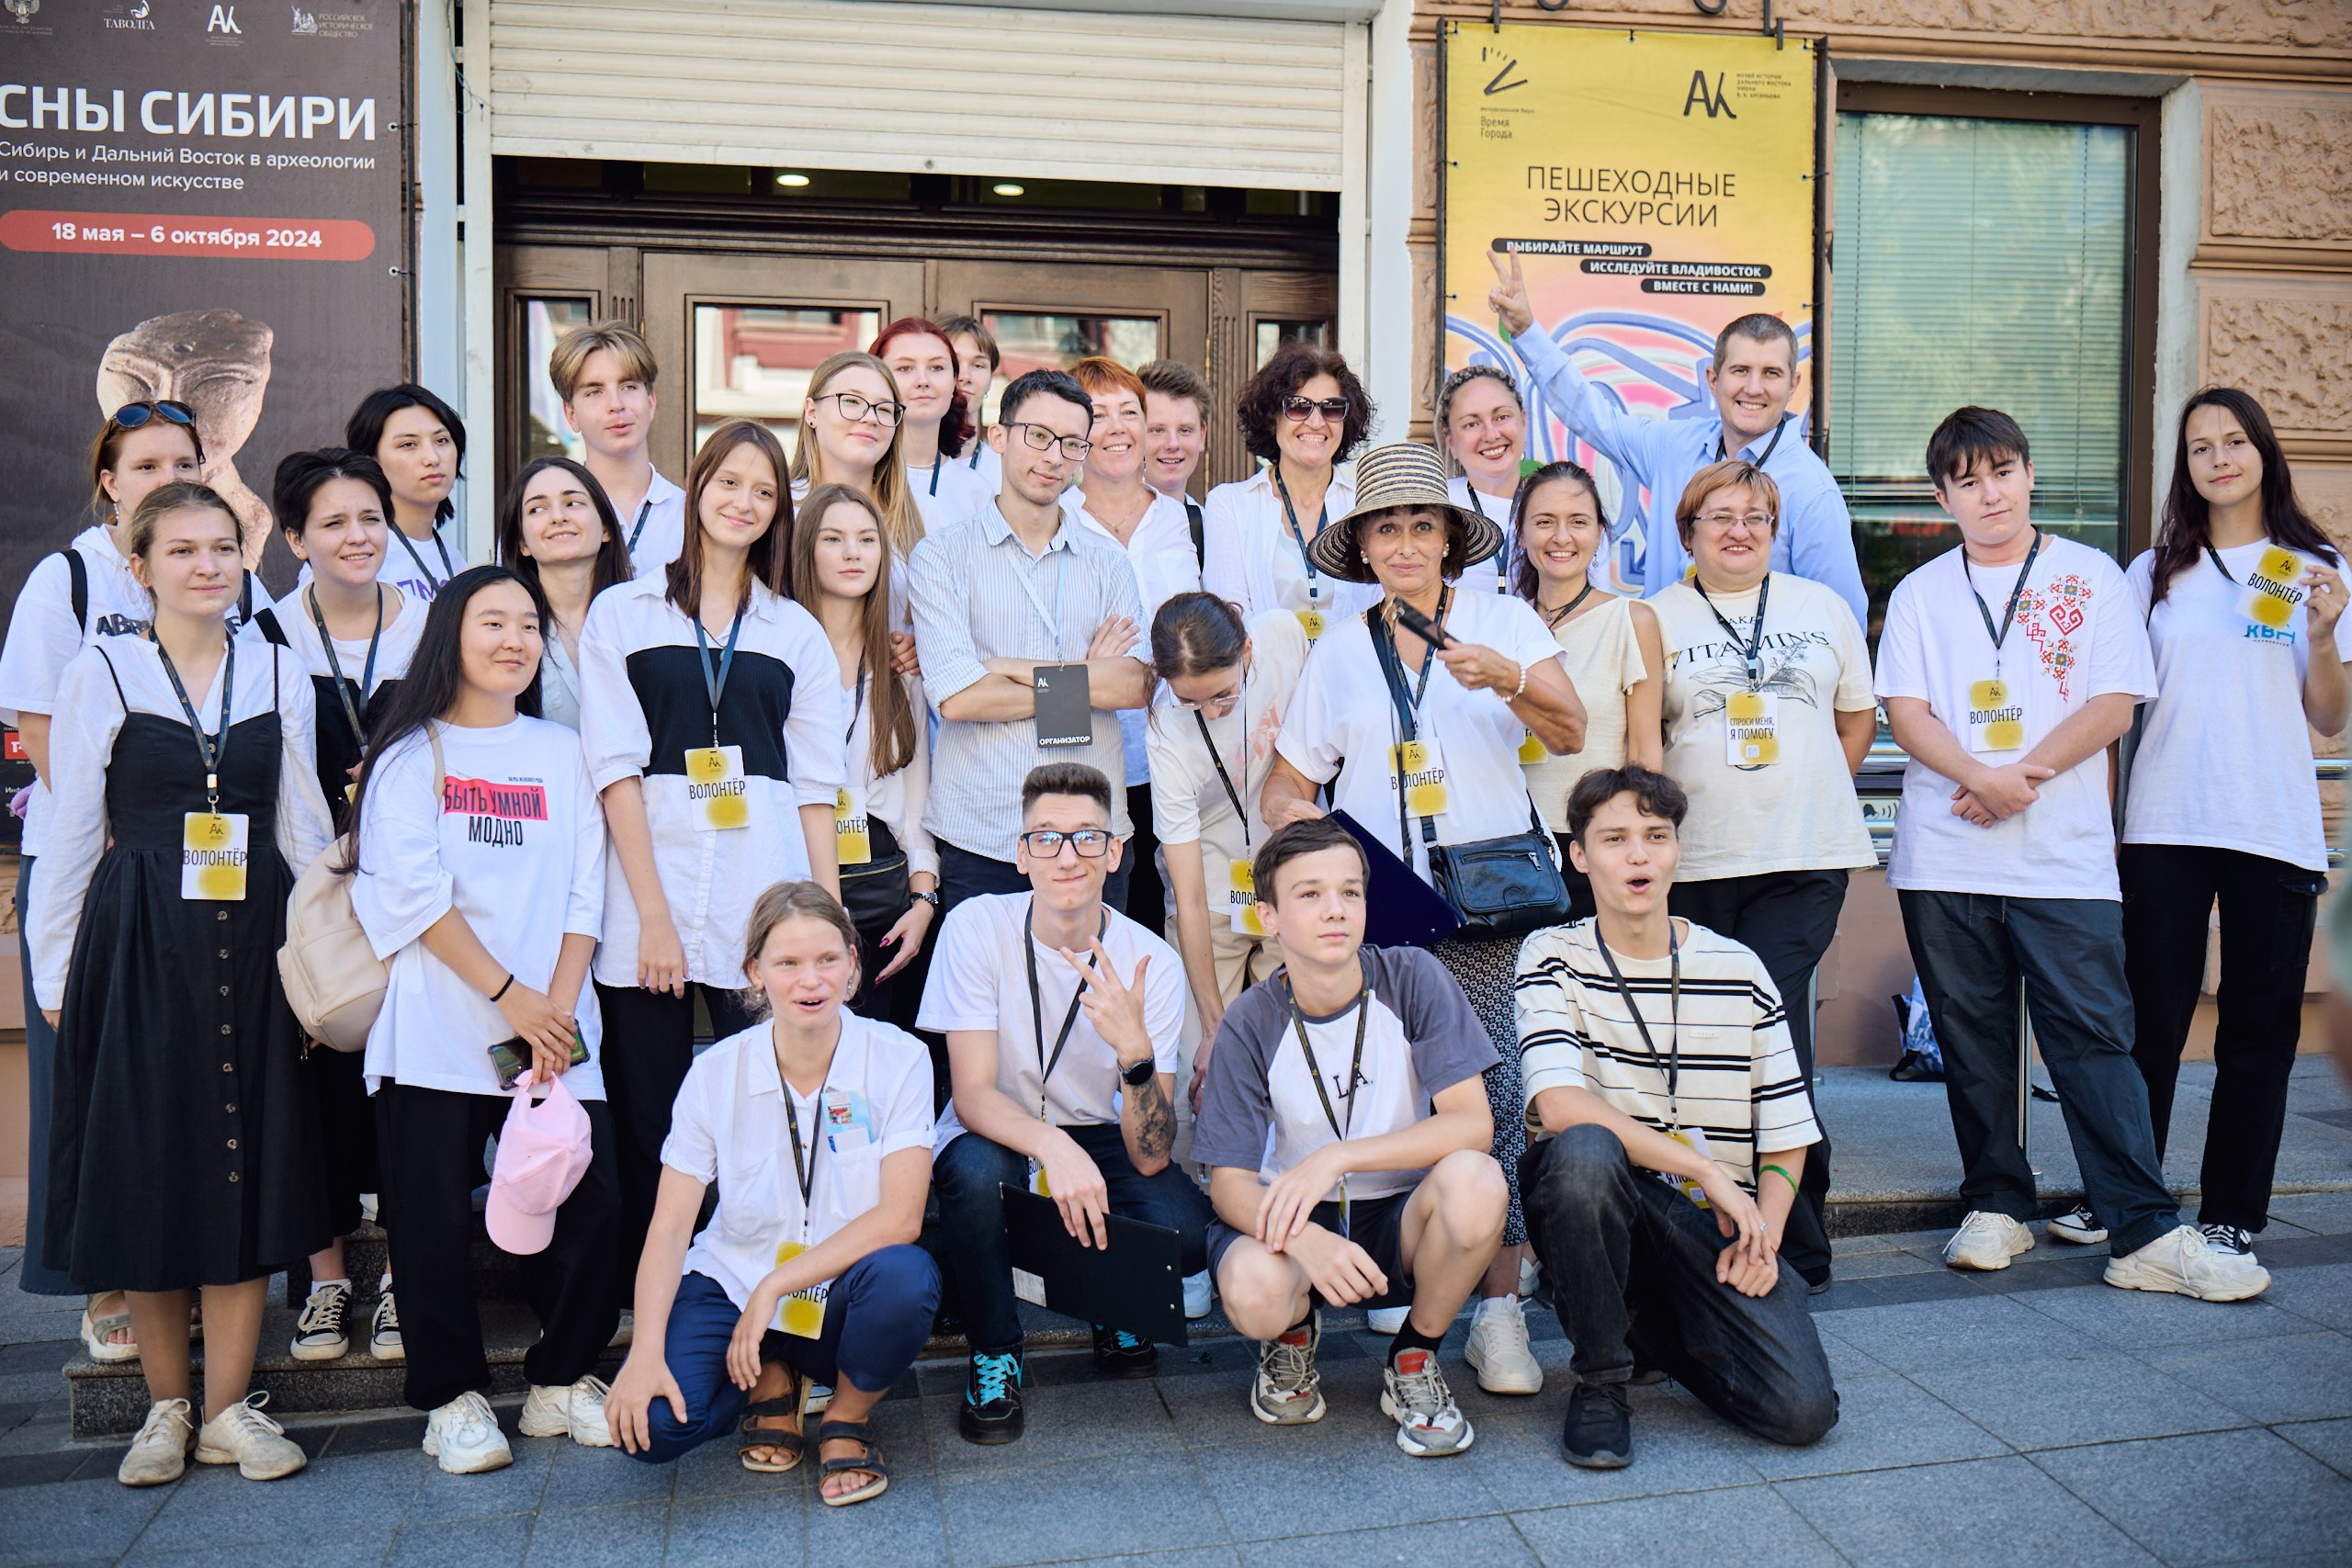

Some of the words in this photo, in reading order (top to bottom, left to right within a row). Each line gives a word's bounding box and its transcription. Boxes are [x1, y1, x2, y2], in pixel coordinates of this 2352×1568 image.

[103, 17, 155, 30] ТАВОЛГА
[319, 13, 366, 22] РОССИЙСКОЕ
[319, 21, 374, 30] ИСТОРИЧЕСКОЕ
[319, 29, 358, 38] ОБЩЕСТВО
[0, 84, 125, 132] СНЫ
[141, 90, 376, 141] СИБИРИ
[1480, 116, 1510, 128] Время
[1480, 128, 1512, 140] Города
[0, 141, 70, 162] Сибирь
[75, 148, 86, 160] и
[92, 144, 175, 164] Дальний
[180, 147, 245, 165] Восток
[250, 153, 261, 166] в
[266, 153, 376, 170] археологии
[0, 169, 8, 182] и
[14, 169, 145, 186] современном
[151, 174, 244, 191] искусстве
[1528, 165, 1736, 200] ПЕШЕХОДНЫЕ
[1544, 197, 1716, 227] ЭКСКУРСИИ
[51, 222, 76, 241] 18
[83, 226, 125, 242] мая
[151, 225, 165, 243] 6
[171, 228, 260, 249] октября
[266, 229, 322, 248] 2024
[1506, 241, 1580, 254] ВЫБИРАЙТЕ
[1582, 243, 1644, 256] МАРШРУТ
[1589, 260, 1669, 276] ИССЛЕДУЙТЕ
[1671, 265, 1762, 278] ВЛАДИВОСТОК
[1653, 280, 1700, 293] ВМЕСТЕ
[1702, 281, 1711, 293] С
[1713, 282, 1754, 294] НАМИ!
[2247, 572, 2303, 604] ВОЛОНТЁР
[1729, 716, 1754, 727] СПРОСИ
[1755, 716, 1775, 727] МЕНЯ,
[1970, 705, 2023, 725] ВОЛОНТЁР
[1038, 736, 1091, 746] ОРГАНИЗАТОР
[1730, 728, 1736, 740] Я
[1737, 728, 1774, 740] ПОМОГУ
[1390, 767, 1444, 790] ВЛОНТЁР
[689, 777, 746, 800] ВОЛОНТЁР
[445, 784, 488, 812] БЫТЬ
[489, 787, 542, 818] УМНОЙ
[469, 816, 524, 849] МОДНО
[836, 816, 868, 835] ОНТЁР
[184, 847, 248, 867] ВОЛОНТЁР
